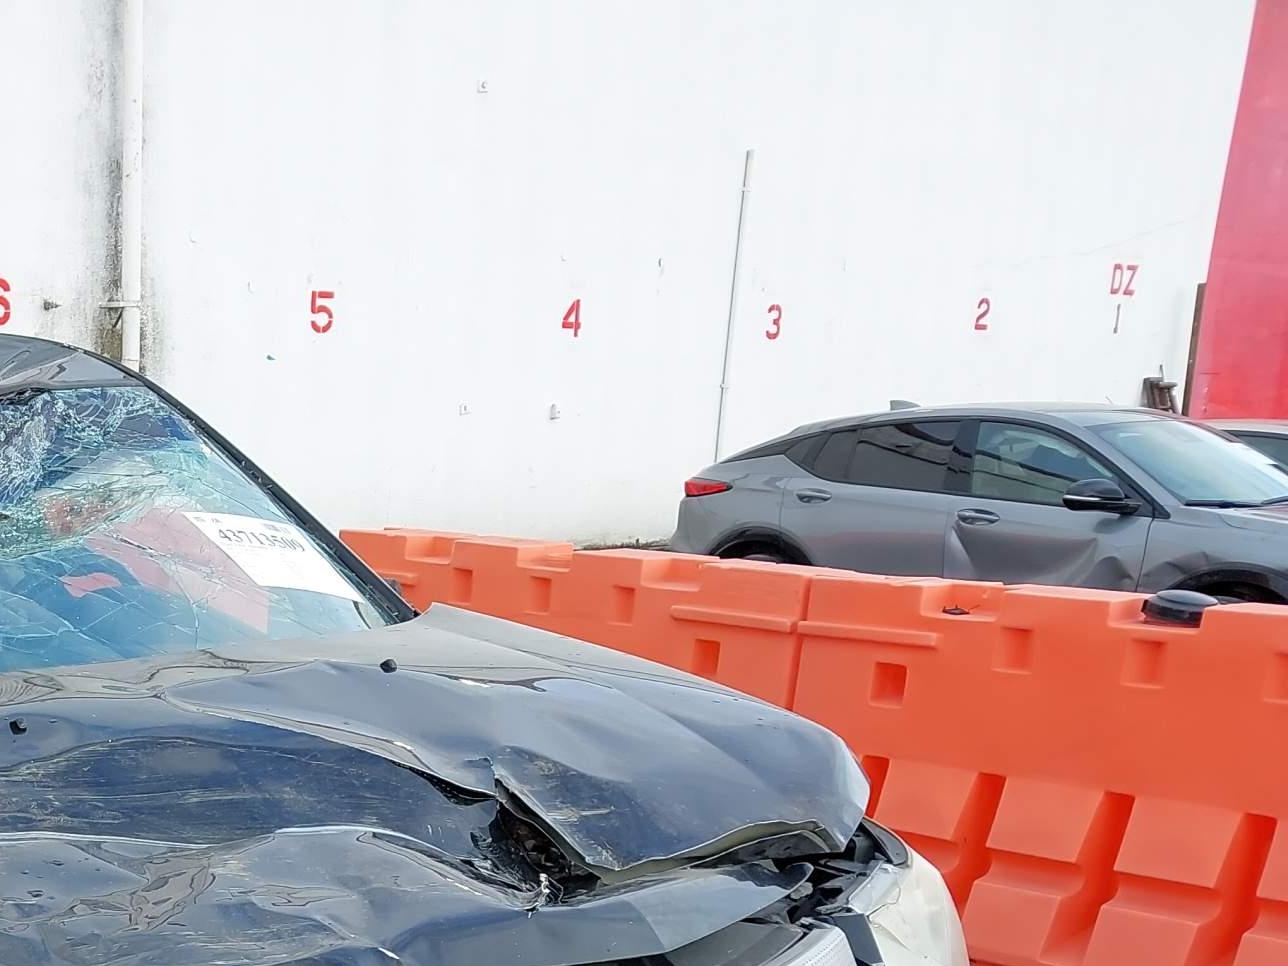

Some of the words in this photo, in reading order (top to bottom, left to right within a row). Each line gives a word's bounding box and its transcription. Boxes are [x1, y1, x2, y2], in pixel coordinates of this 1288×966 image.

[1110, 263, 1139, 297] DZ
[310, 290, 336, 334] 5
[561, 299, 583, 338] 4
[765, 303, 783, 341] 3
[974, 298, 991, 331] 2
